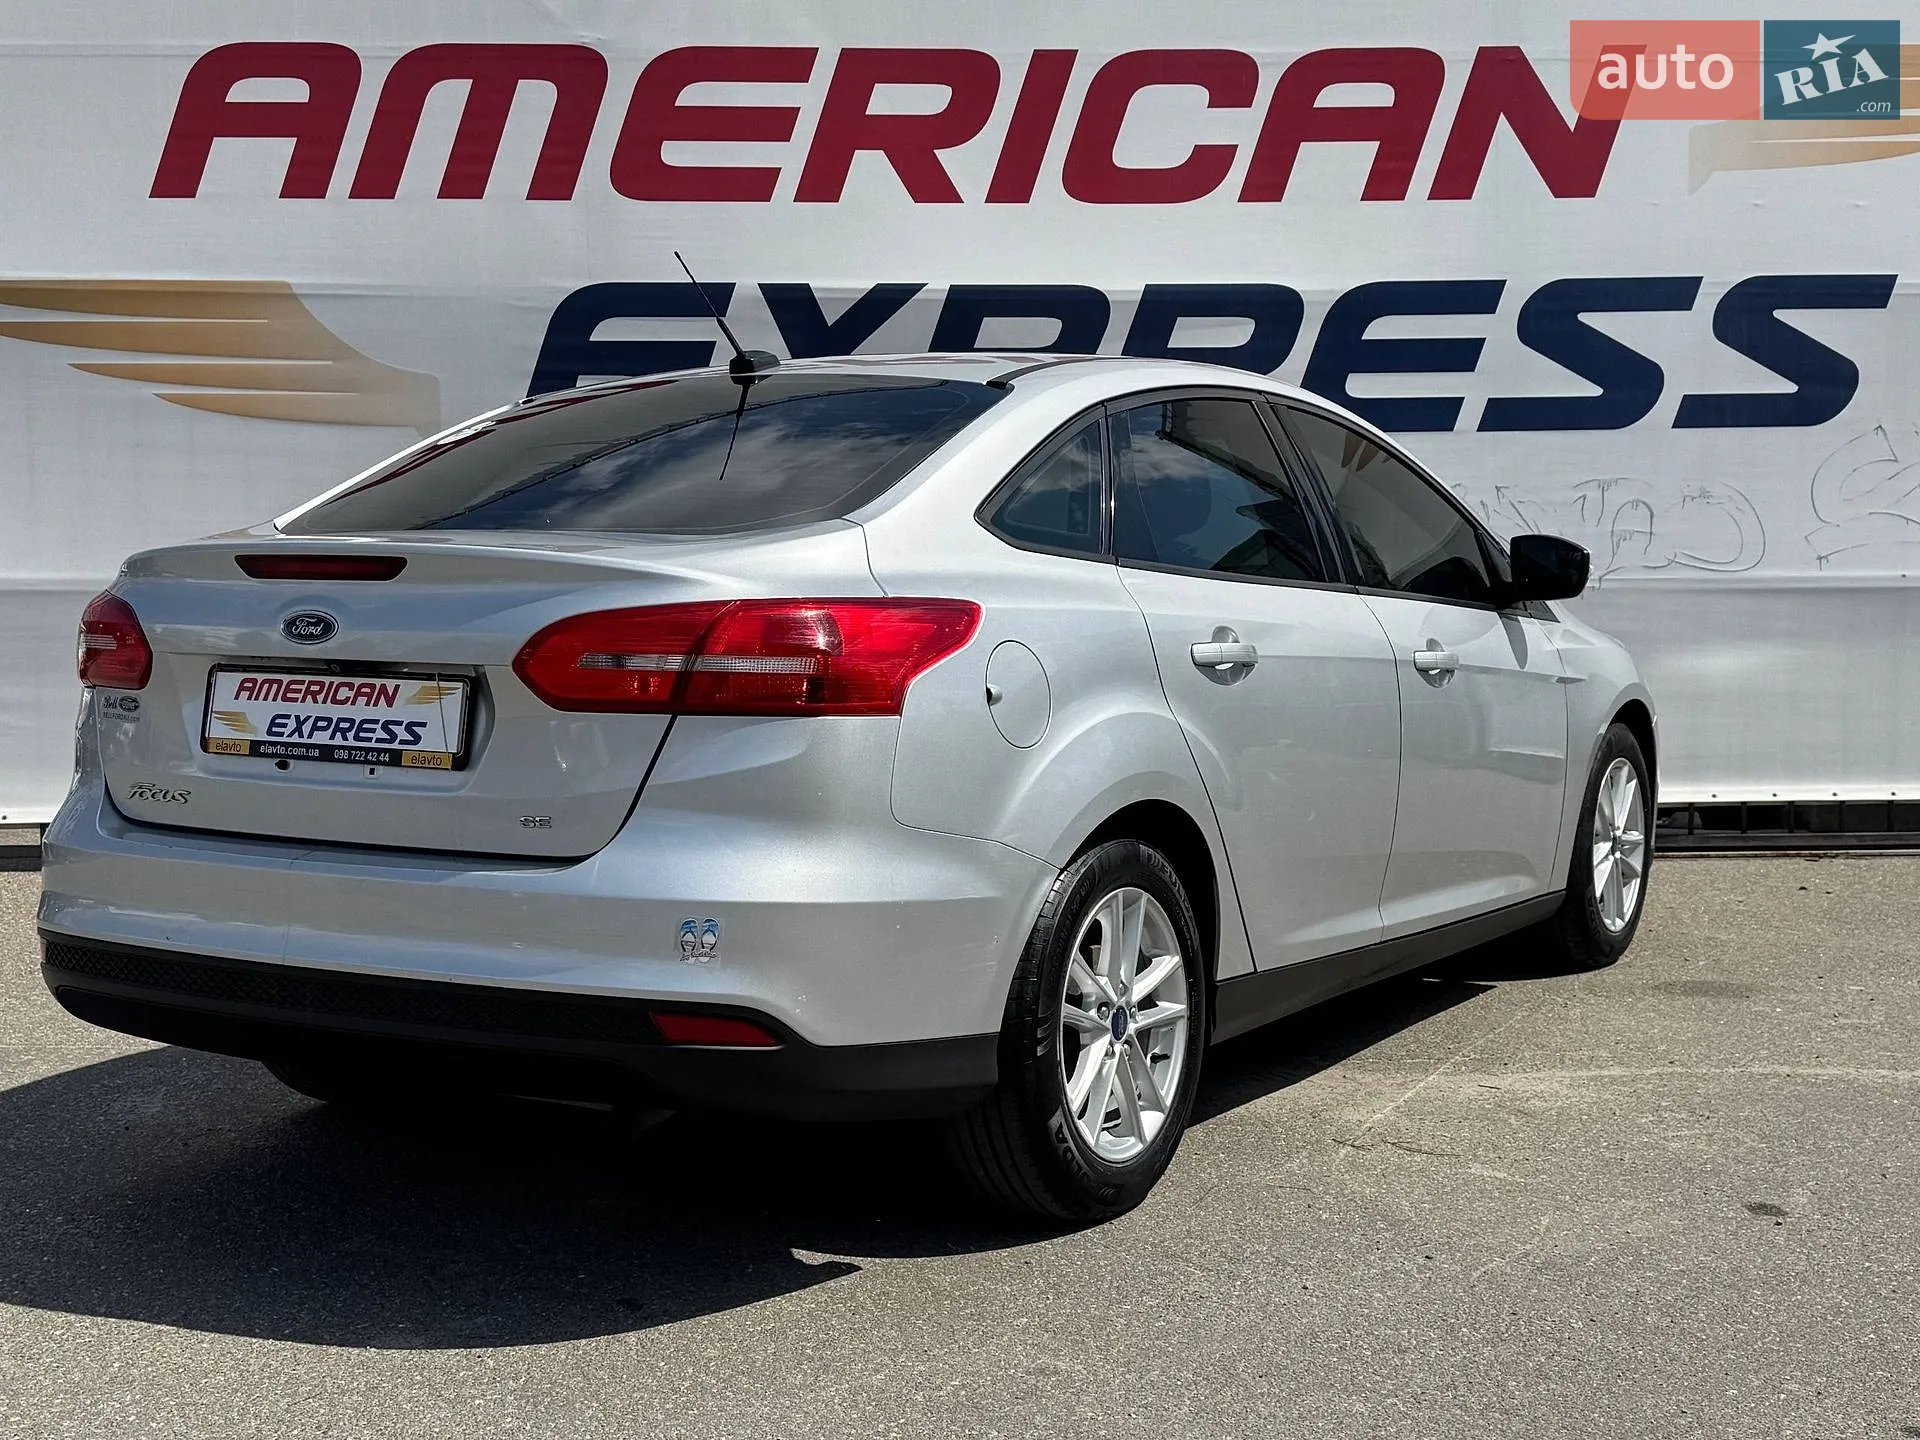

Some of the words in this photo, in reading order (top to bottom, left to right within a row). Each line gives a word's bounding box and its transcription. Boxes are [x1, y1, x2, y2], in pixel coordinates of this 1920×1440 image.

[149, 42, 1648, 204] AMERICAN
[291, 616, 325, 635] Ford
[233, 677, 401, 709] AMERICAN
[265, 713, 428, 746] EXPRESS
[215, 740, 242, 753] elavto
[259, 743, 320, 758] elavto.com.ua
[333, 748, 349, 760] 098
[350, 750, 366, 761] 722
[366, 751, 377, 762] 42
[378, 752, 390, 763] 44
[410, 753, 443, 767] elavto
[519, 815, 553, 829] SE
